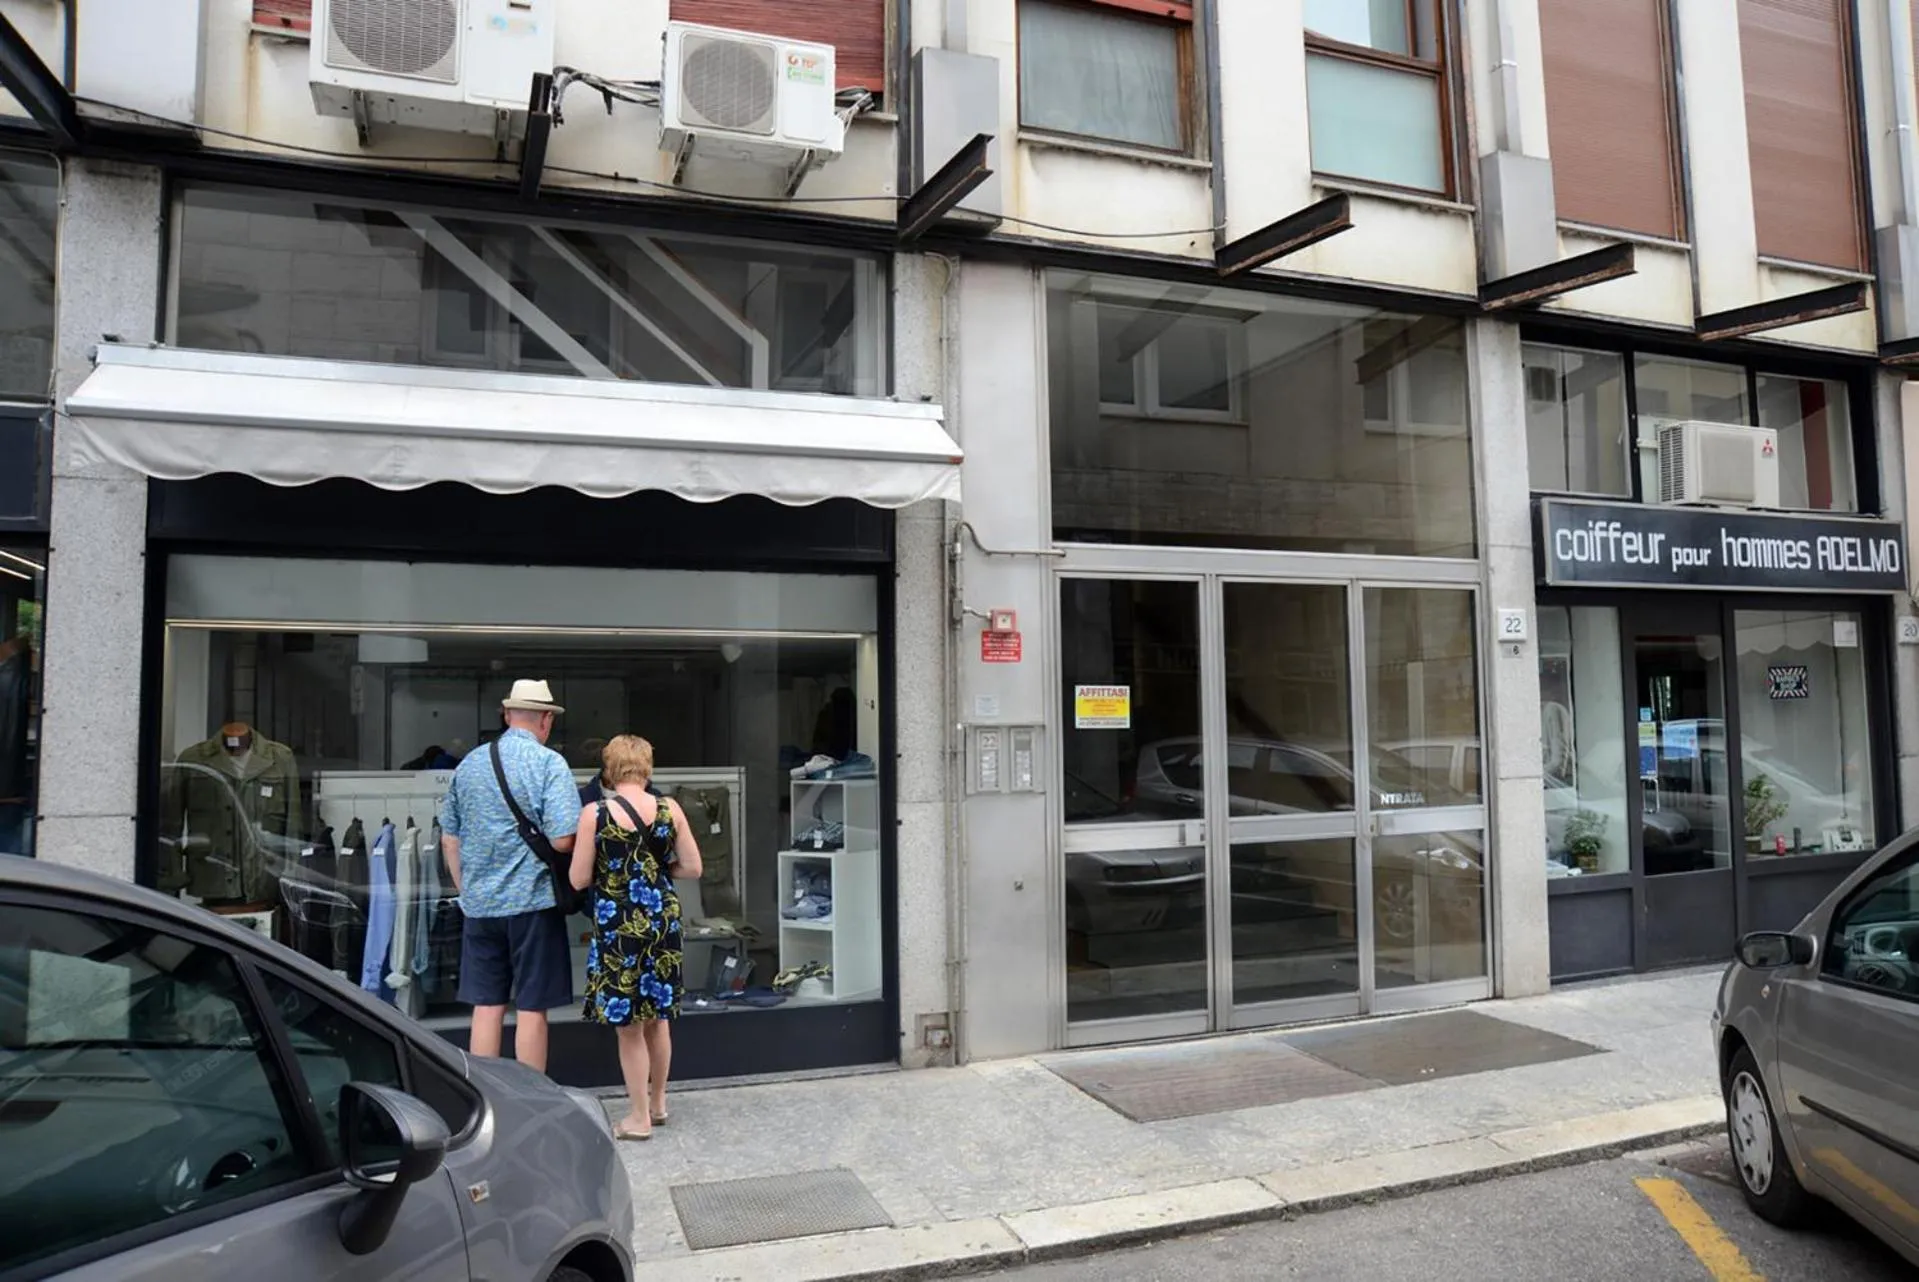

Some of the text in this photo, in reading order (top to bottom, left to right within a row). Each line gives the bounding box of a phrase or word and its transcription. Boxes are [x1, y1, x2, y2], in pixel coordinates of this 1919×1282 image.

[1555, 520, 1901, 573] coiffeur pour hommes ADELMO
[1504, 616, 1522, 633] 22
[1079, 687, 1128, 697] AFFITTASI
